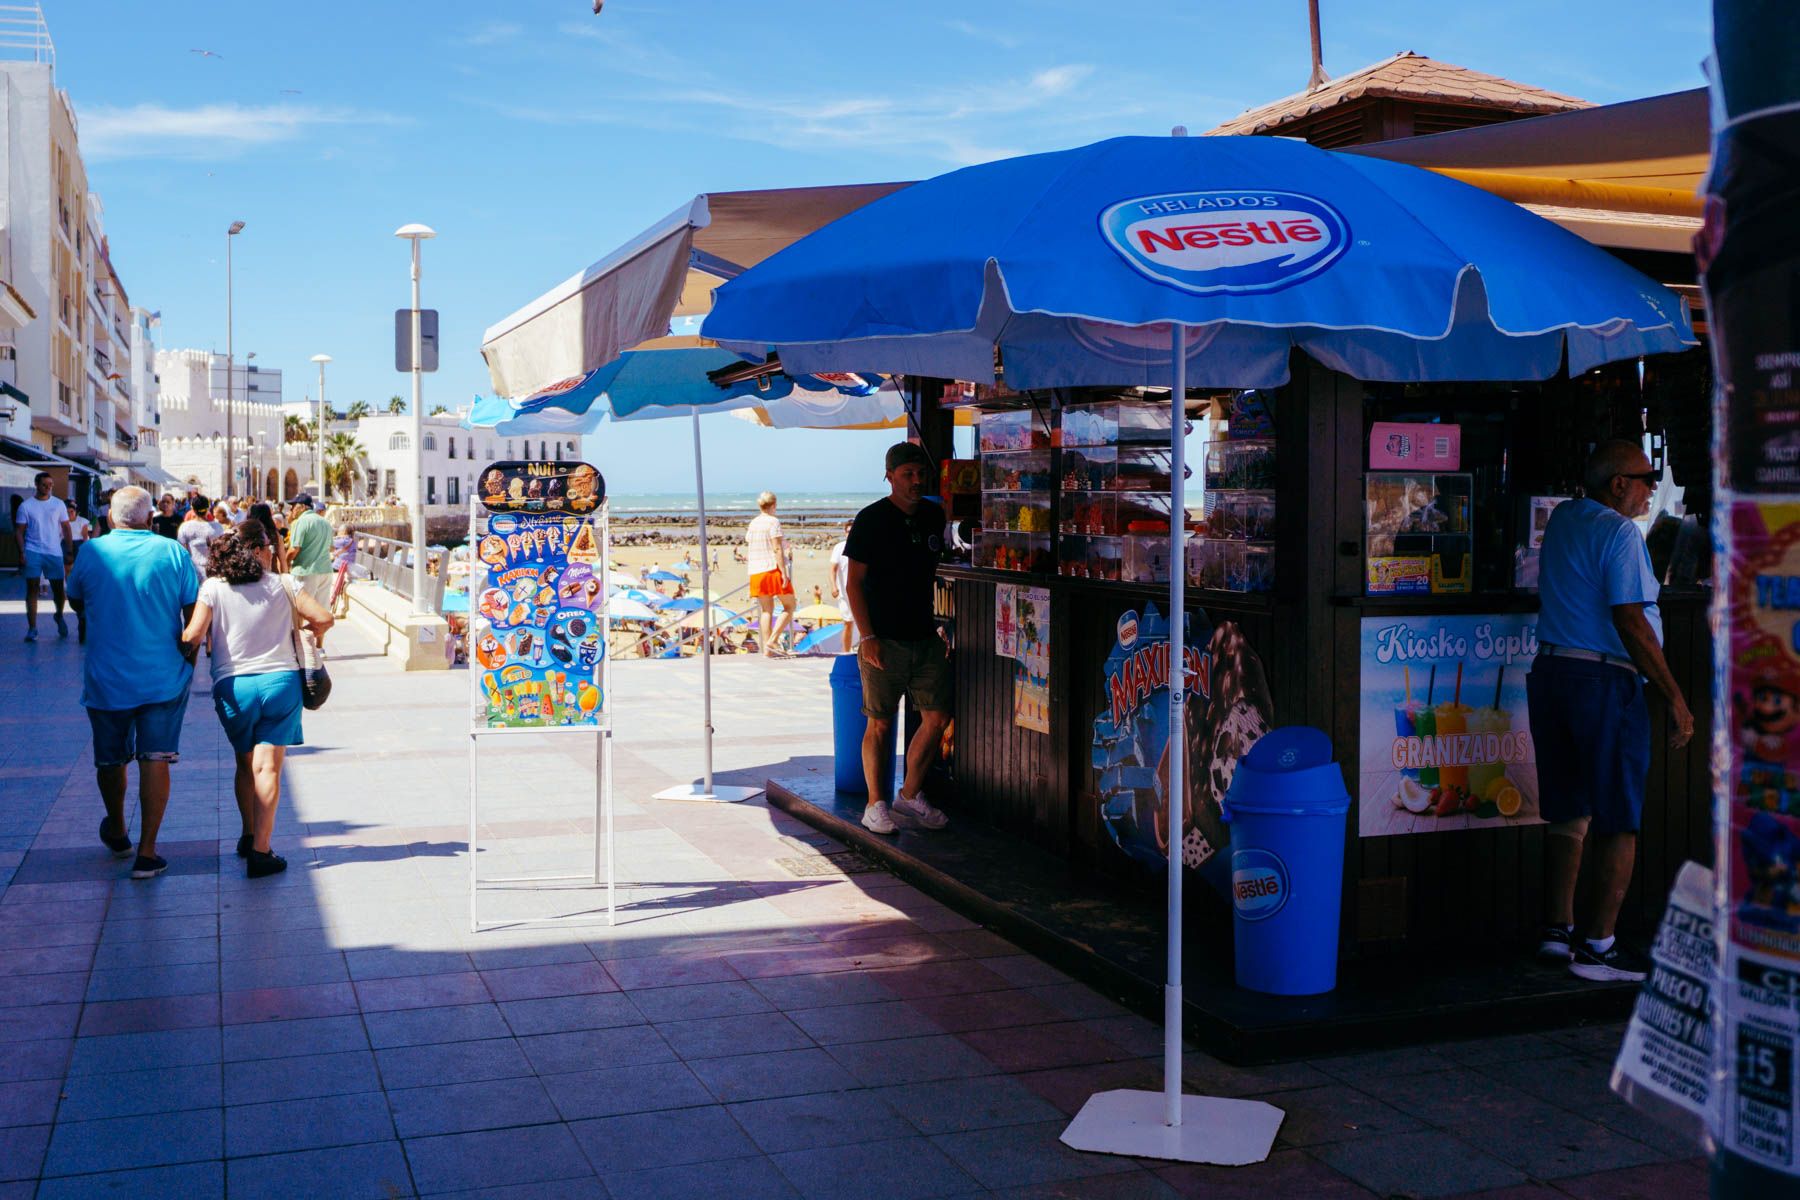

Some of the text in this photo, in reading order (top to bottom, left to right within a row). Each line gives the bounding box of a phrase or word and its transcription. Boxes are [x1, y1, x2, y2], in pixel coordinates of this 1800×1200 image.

[1138, 195, 1279, 215] HELADOS
[1136, 218, 1323, 254] Nestlé
[1416, 576, 1429, 585] 20
[556, 610, 586, 620] OREO
[1376, 623, 1467, 664] Kiosko
[1110, 641, 1212, 729] MAXION
[1391, 731, 1529, 770] GRANIZADOS
[1743, 1044, 1777, 1088] 15
